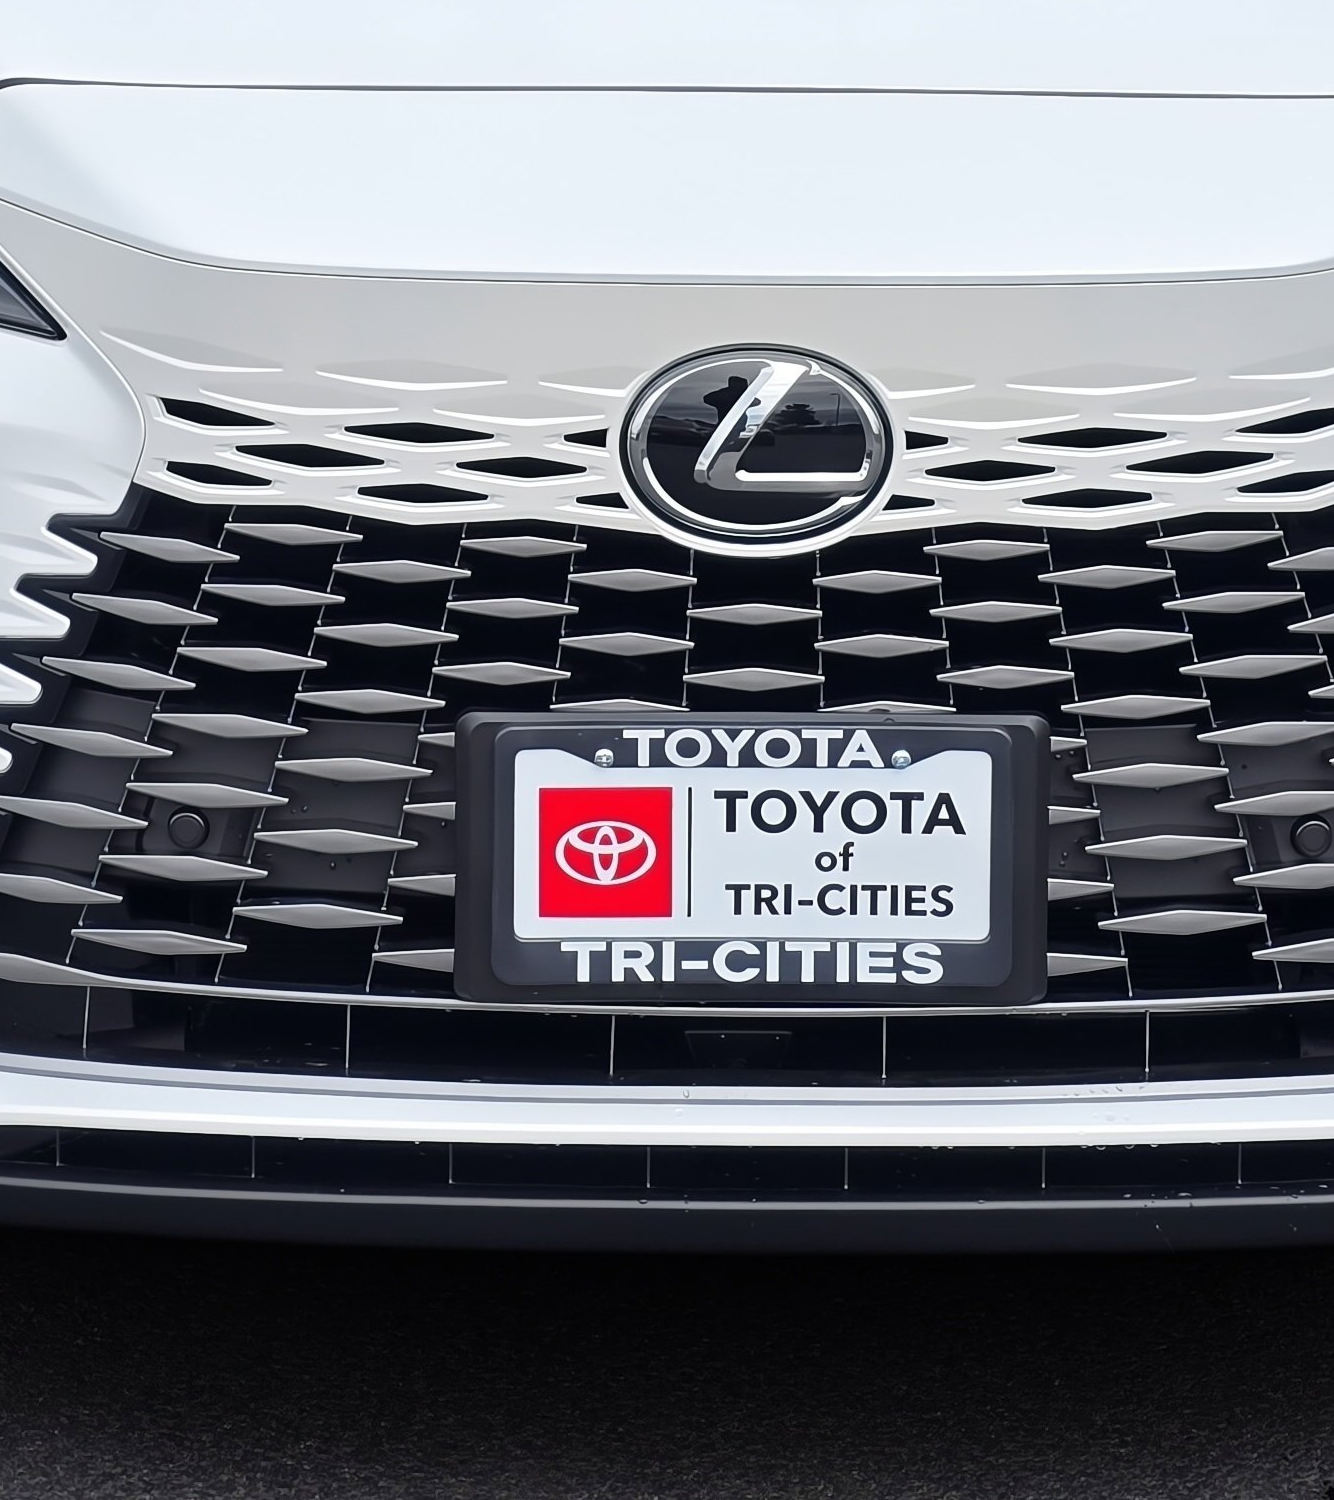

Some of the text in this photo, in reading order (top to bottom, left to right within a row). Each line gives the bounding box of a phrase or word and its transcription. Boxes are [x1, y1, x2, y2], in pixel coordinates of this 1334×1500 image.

[622, 729, 885, 768] TOYOTA
[713, 789, 967, 835] TOYOTA
[814, 842, 855, 873] of
[724, 883, 955, 917] TRI-CITIES
[560, 940, 945, 984] TRI-CITIES
